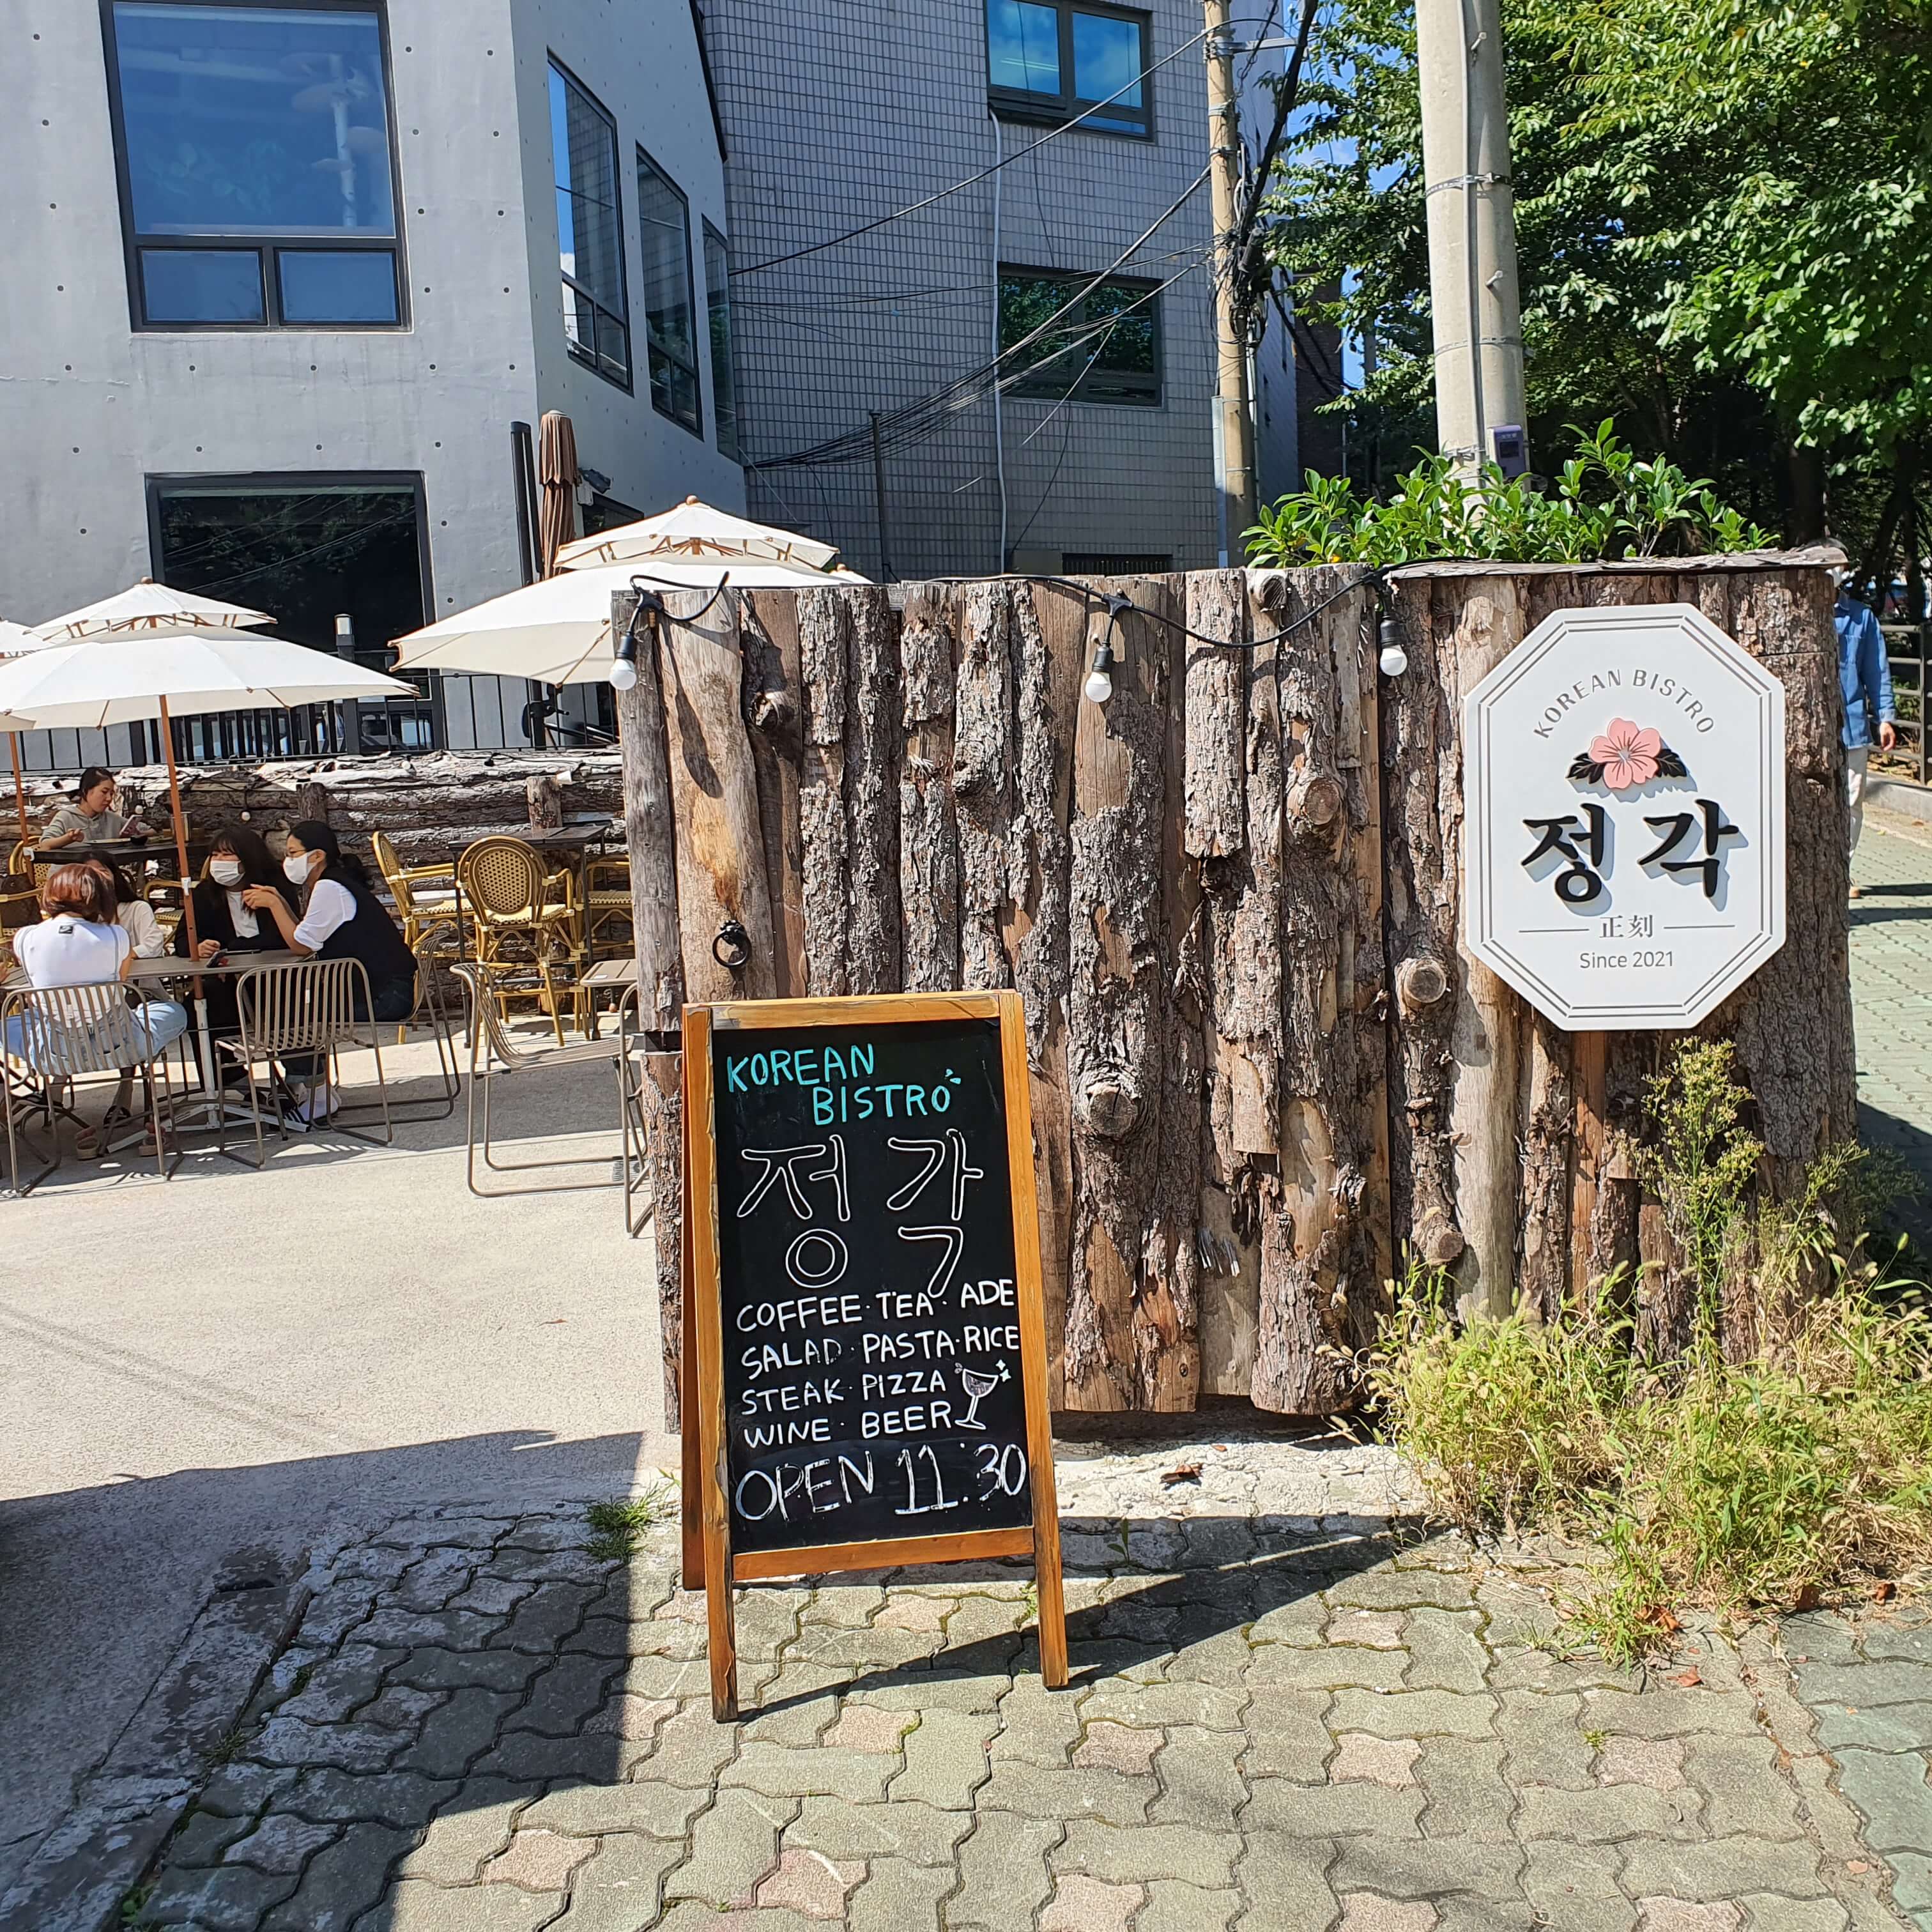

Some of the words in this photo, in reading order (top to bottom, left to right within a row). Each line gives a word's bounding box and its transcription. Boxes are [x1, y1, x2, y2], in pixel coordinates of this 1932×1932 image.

[1533, 669, 1621, 739] KOREAN
[1633, 669, 1714, 733] BISTRO
[1521, 799, 1739, 903] 정각
[1599, 914, 1653, 939] 正刻
[1580, 952, 1627, 969] Since
[1632, 951, 1673, 967] 2021
[726, 1043, 873, 1092] KOREAN
[813, 1084, 951, 1125] BISTRO
[736, 1128, 985, 1299] 정각
[736, 1294, 862, 1332] COFFEE
[876, 1291, 935, 1319] TEA
[960, 1279, 1015, 1308] ADE
[740, 1338, 842, 1380] SALAD
[862, 1329, 955, 1364] PASTA
[963, 1325, 1020, 1354] RICE
[741, 1378, 845, 1416] STEAK
[862, 1370, 946, 1401] PIZZA
[744, 1418, 831, 1449] WINE
[861, 1400, 952, 1439] BEER
[735, 1450, 874, 1522] OPEN
